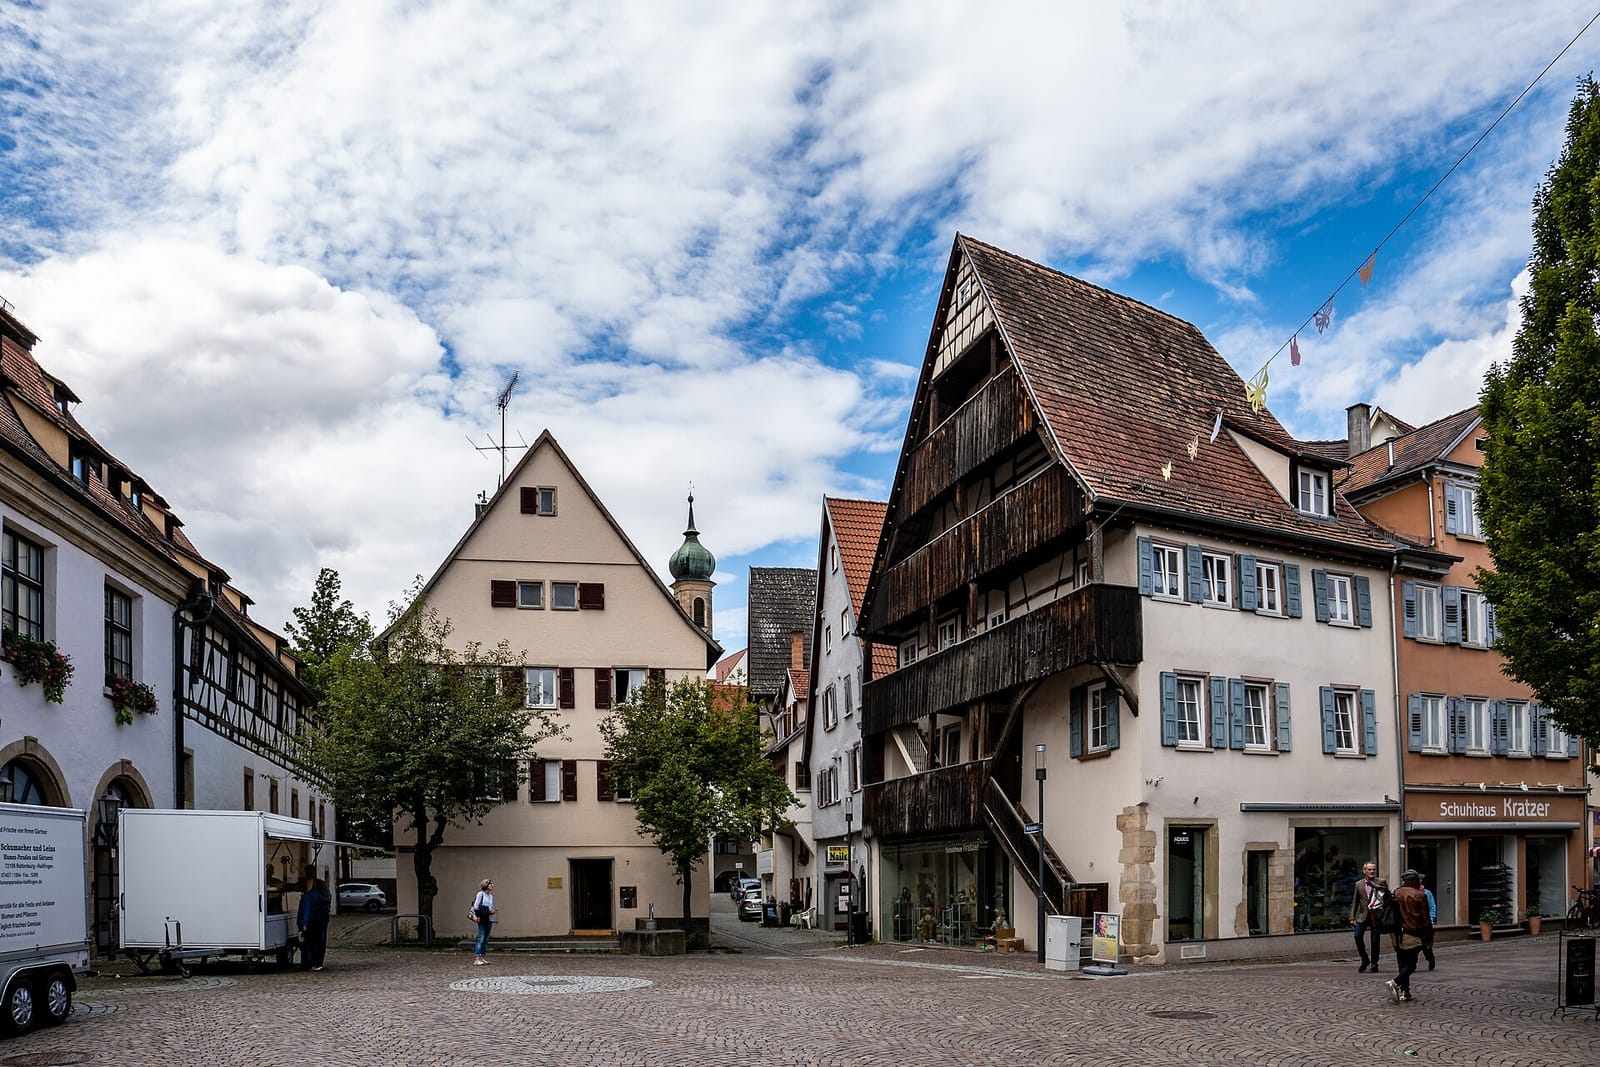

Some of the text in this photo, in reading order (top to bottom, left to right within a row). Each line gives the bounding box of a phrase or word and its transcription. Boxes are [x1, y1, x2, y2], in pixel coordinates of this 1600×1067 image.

[1440, 797, 1550, 817] Schuhhaus Kratzer
[1, 843, 32, 851] Schumacher
